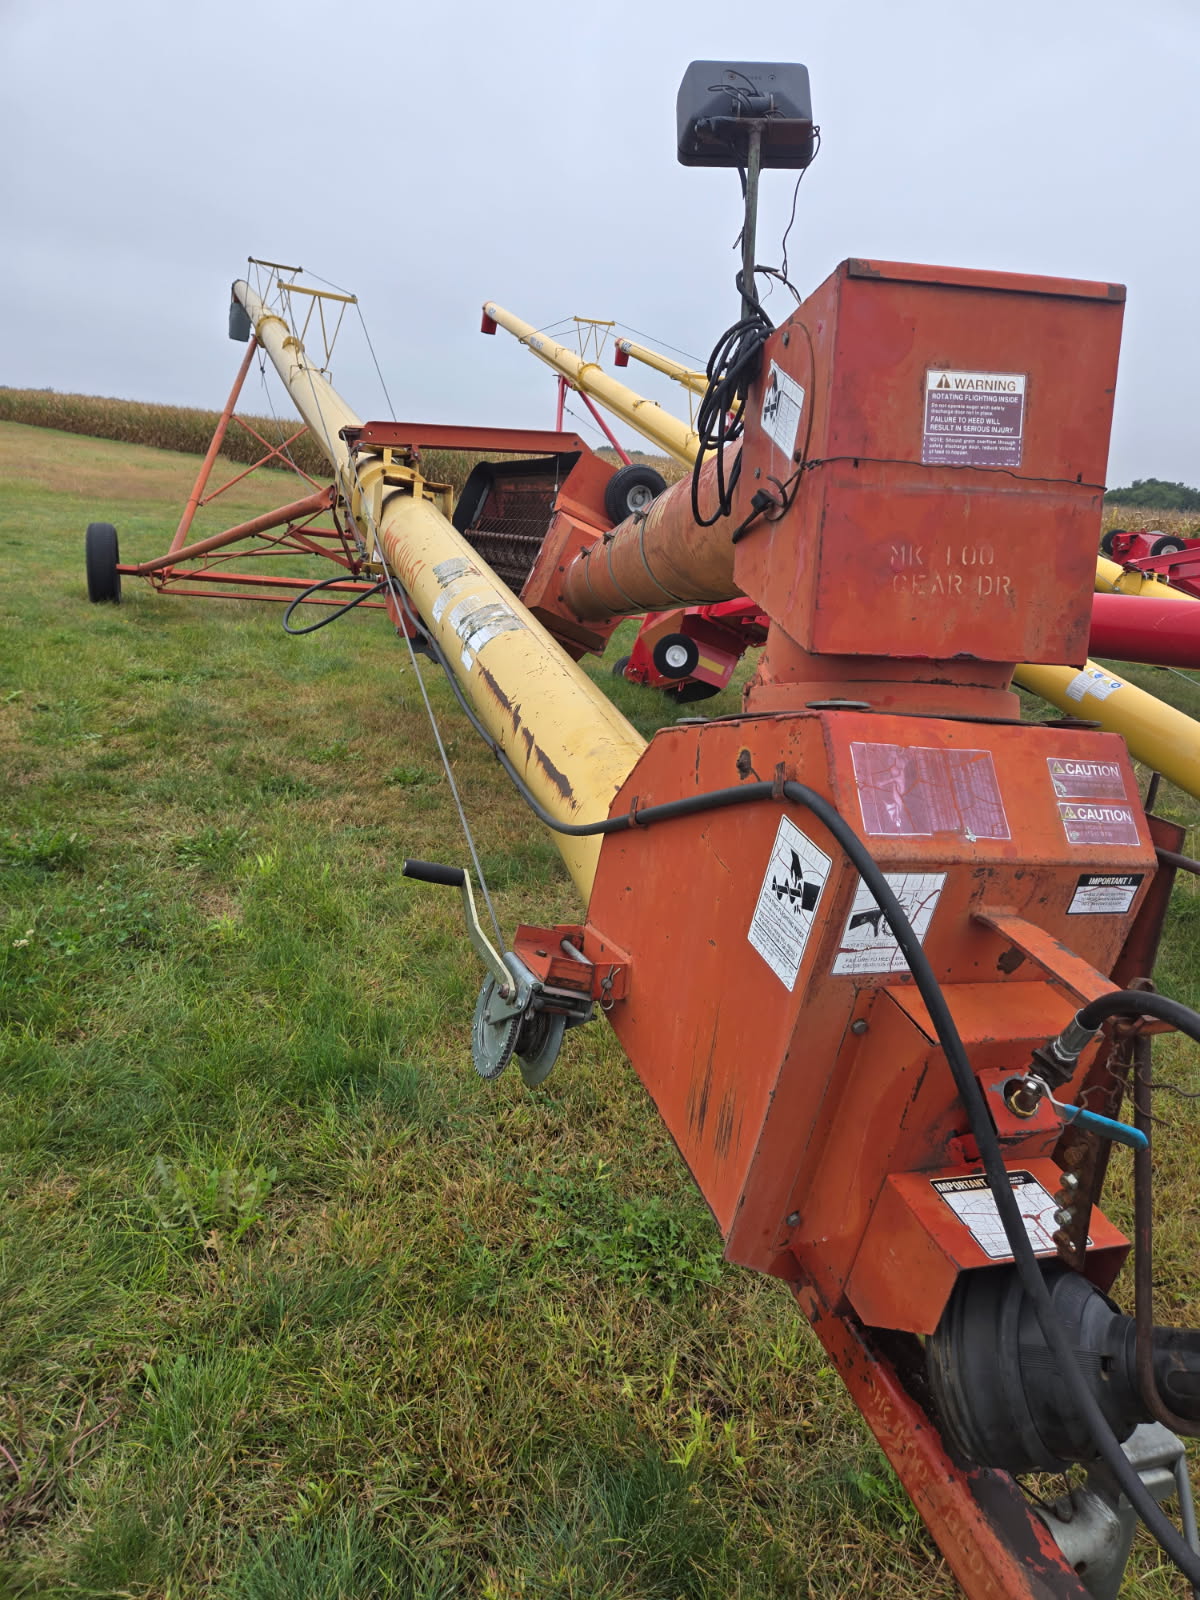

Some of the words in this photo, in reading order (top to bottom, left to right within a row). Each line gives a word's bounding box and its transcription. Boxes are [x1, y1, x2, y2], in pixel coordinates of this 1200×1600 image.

[954, 378, 1016, 392] WARNING
[891, 545, 923, 566] MK
[946, 545, 994, 566] 100
[893, 574, 963, 594] GEAR
[978, 575, 1011, 596] DR
[1065, 763, 1120, 777] CAUTION
[1077, 808, 1132, 822] CAUTION
[1088, 877, 1128, 885] IMPORTANT
[934, 1178, 988, 1193] IMPORTANT
